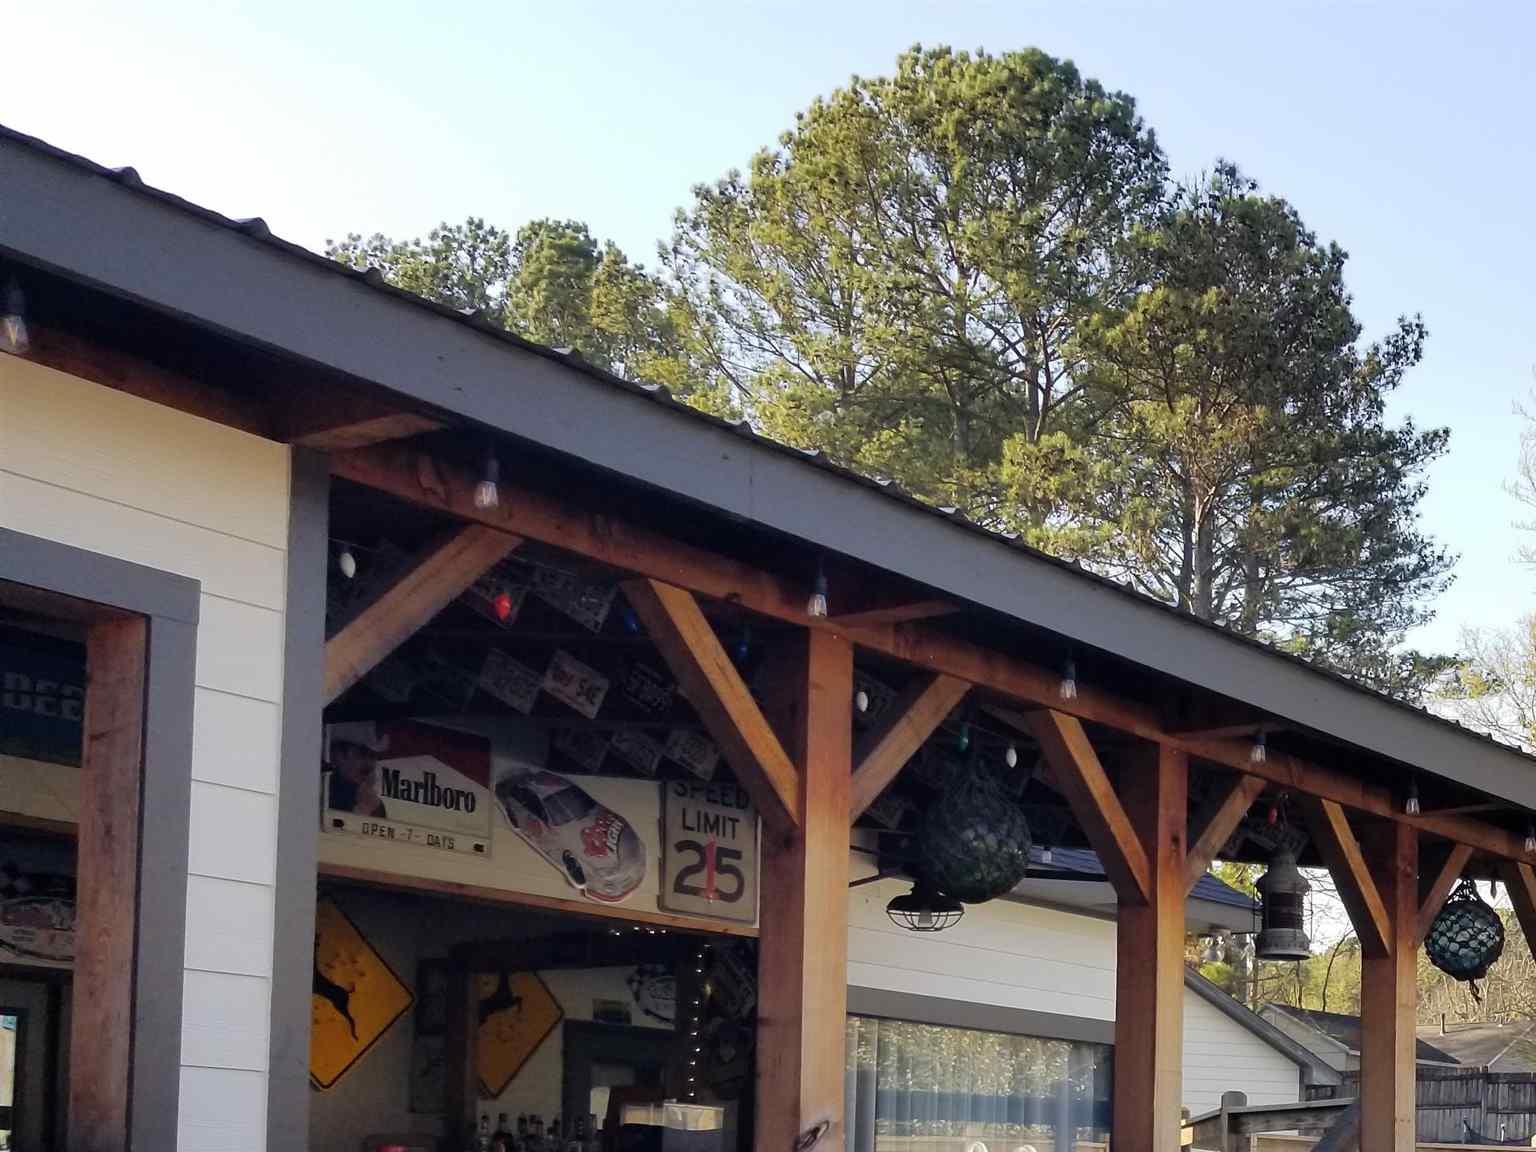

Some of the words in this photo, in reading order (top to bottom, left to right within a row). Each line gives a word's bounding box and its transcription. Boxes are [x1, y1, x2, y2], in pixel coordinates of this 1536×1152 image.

[380, 766, 477, 814] Marlboro
[361, 821, 396, 841] OPEN
[426, 833, 456, 851] DAYS
[682, 807, 740, 841] LIMIT
[673, 839, 745, 904] 25
